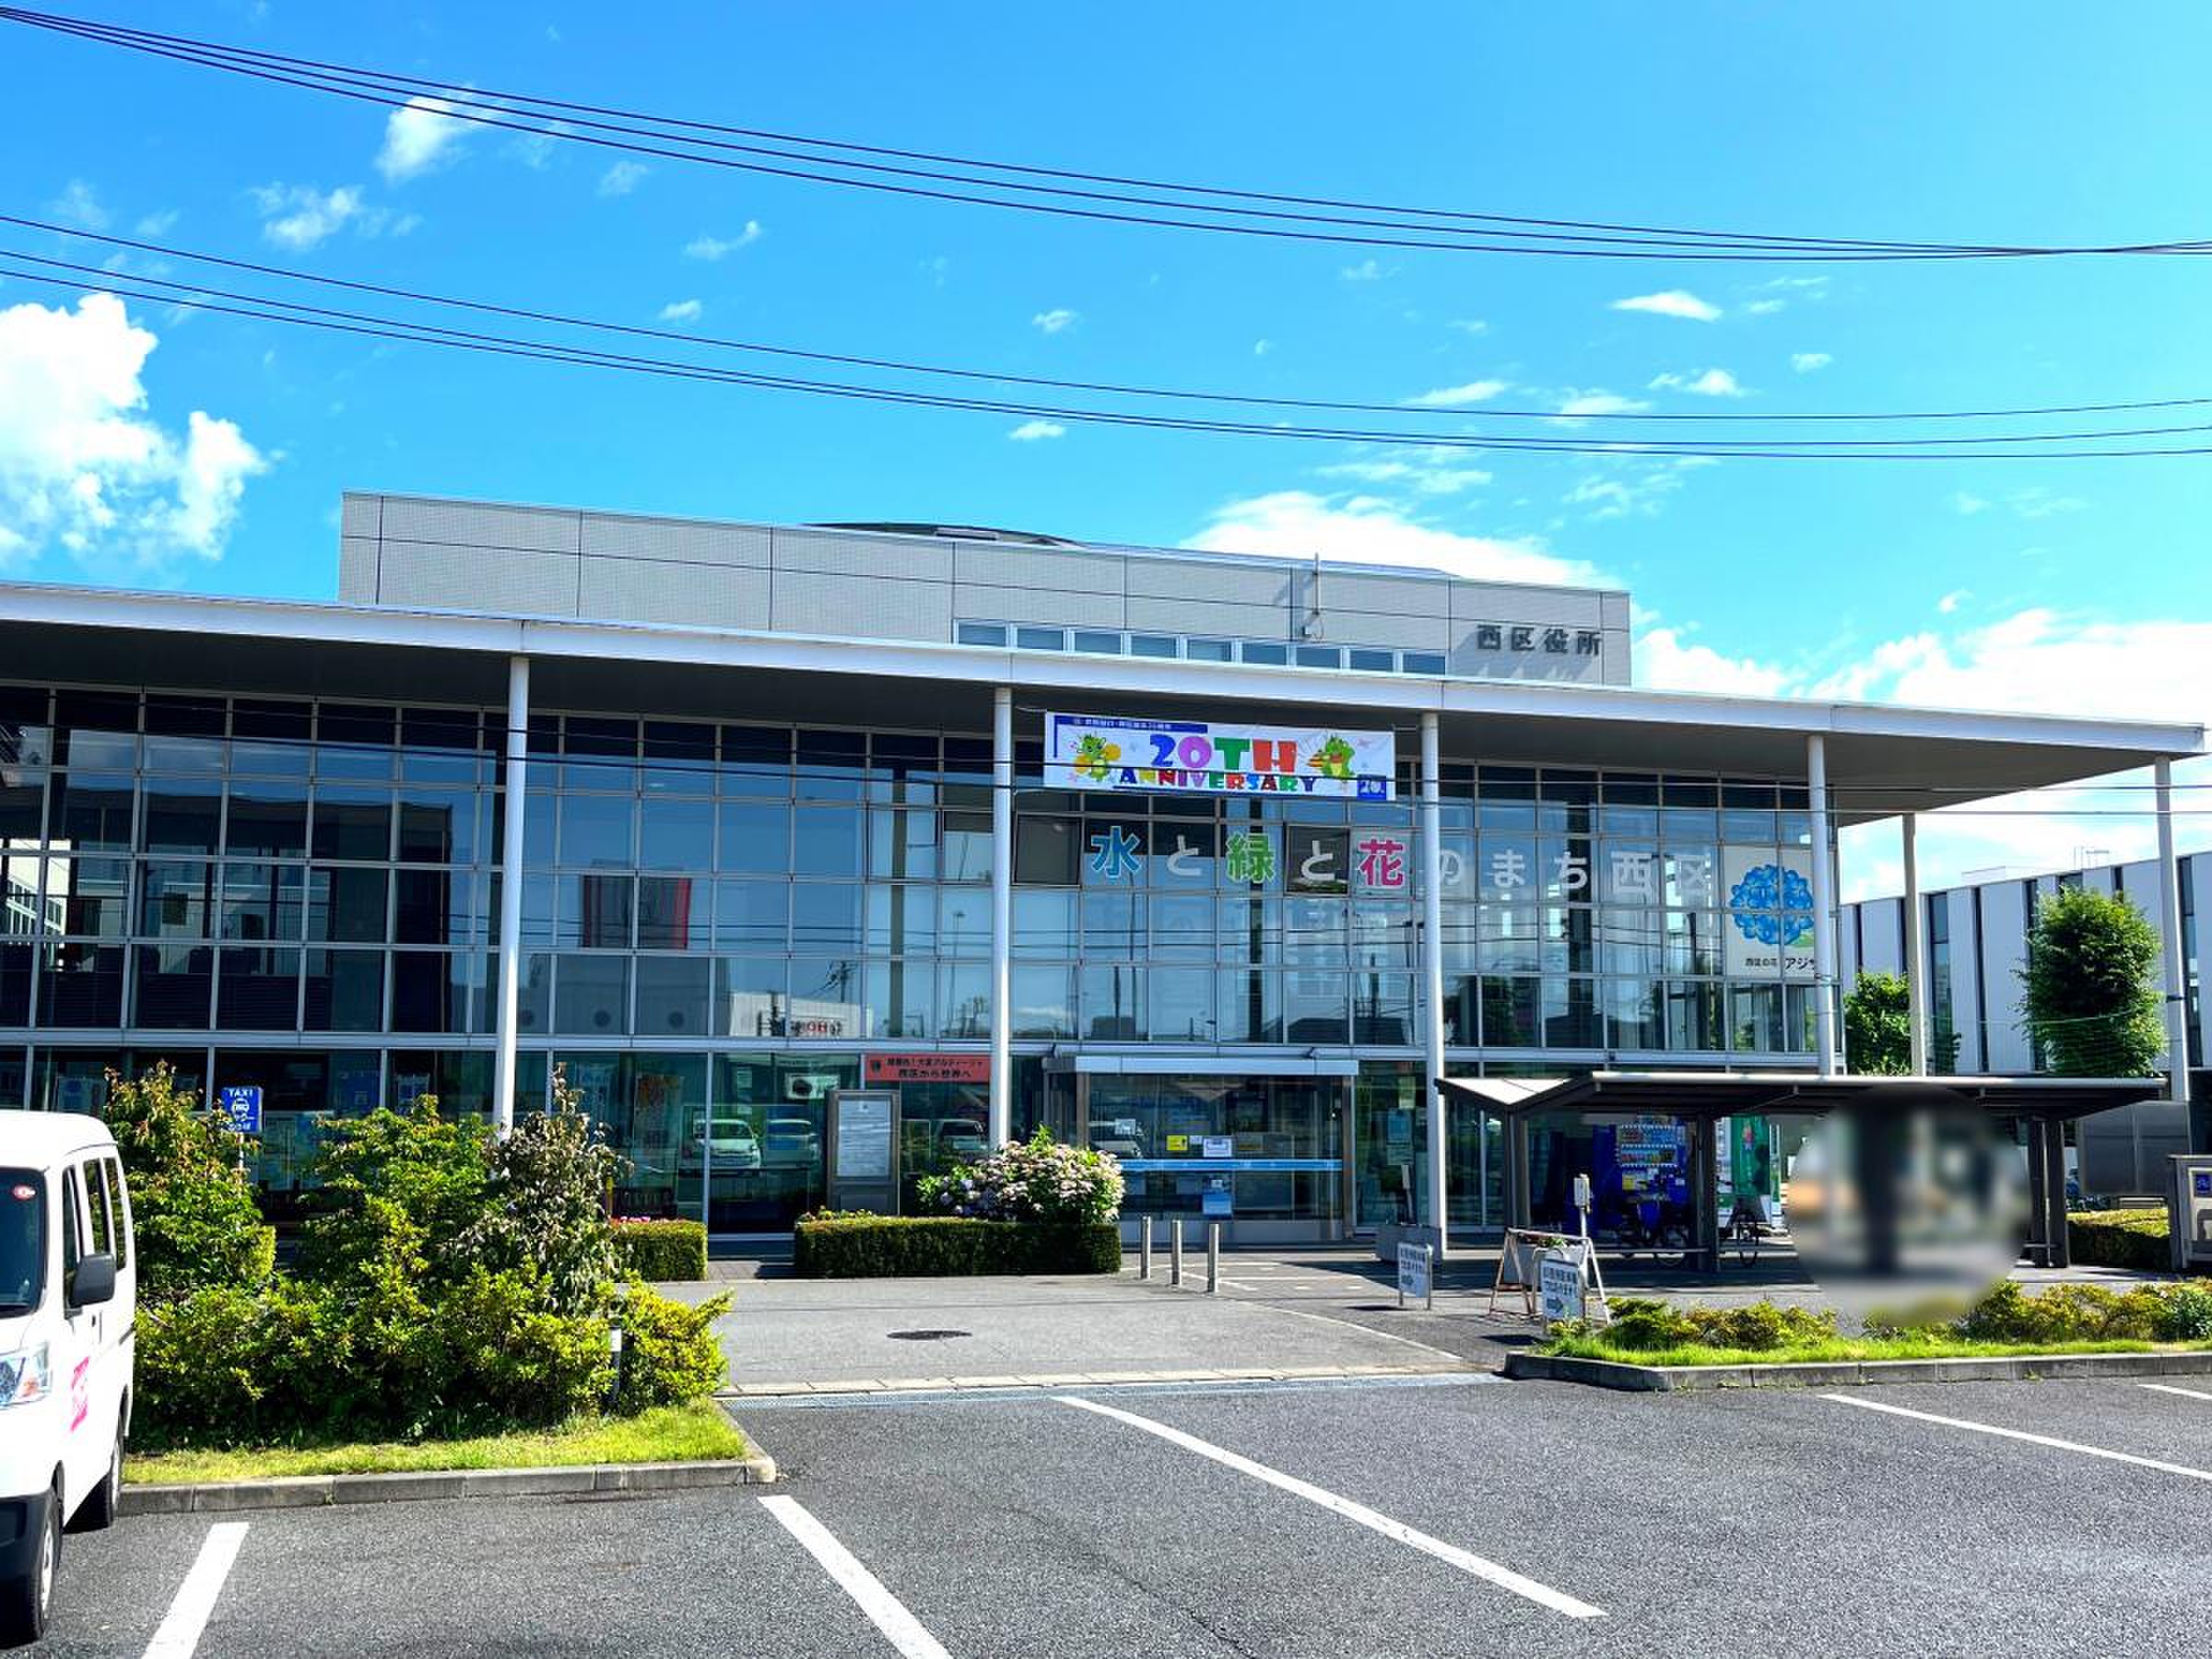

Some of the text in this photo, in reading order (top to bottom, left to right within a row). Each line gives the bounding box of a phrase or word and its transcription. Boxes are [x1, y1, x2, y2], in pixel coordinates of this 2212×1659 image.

[1477, 624, 1603, 656] 西区役所
[1149, 734, 1299, 773] 20TH
[1118, 767, 1318, 793] ANNIVERSARY
[229, 1088, 253, 1097] TAXI
